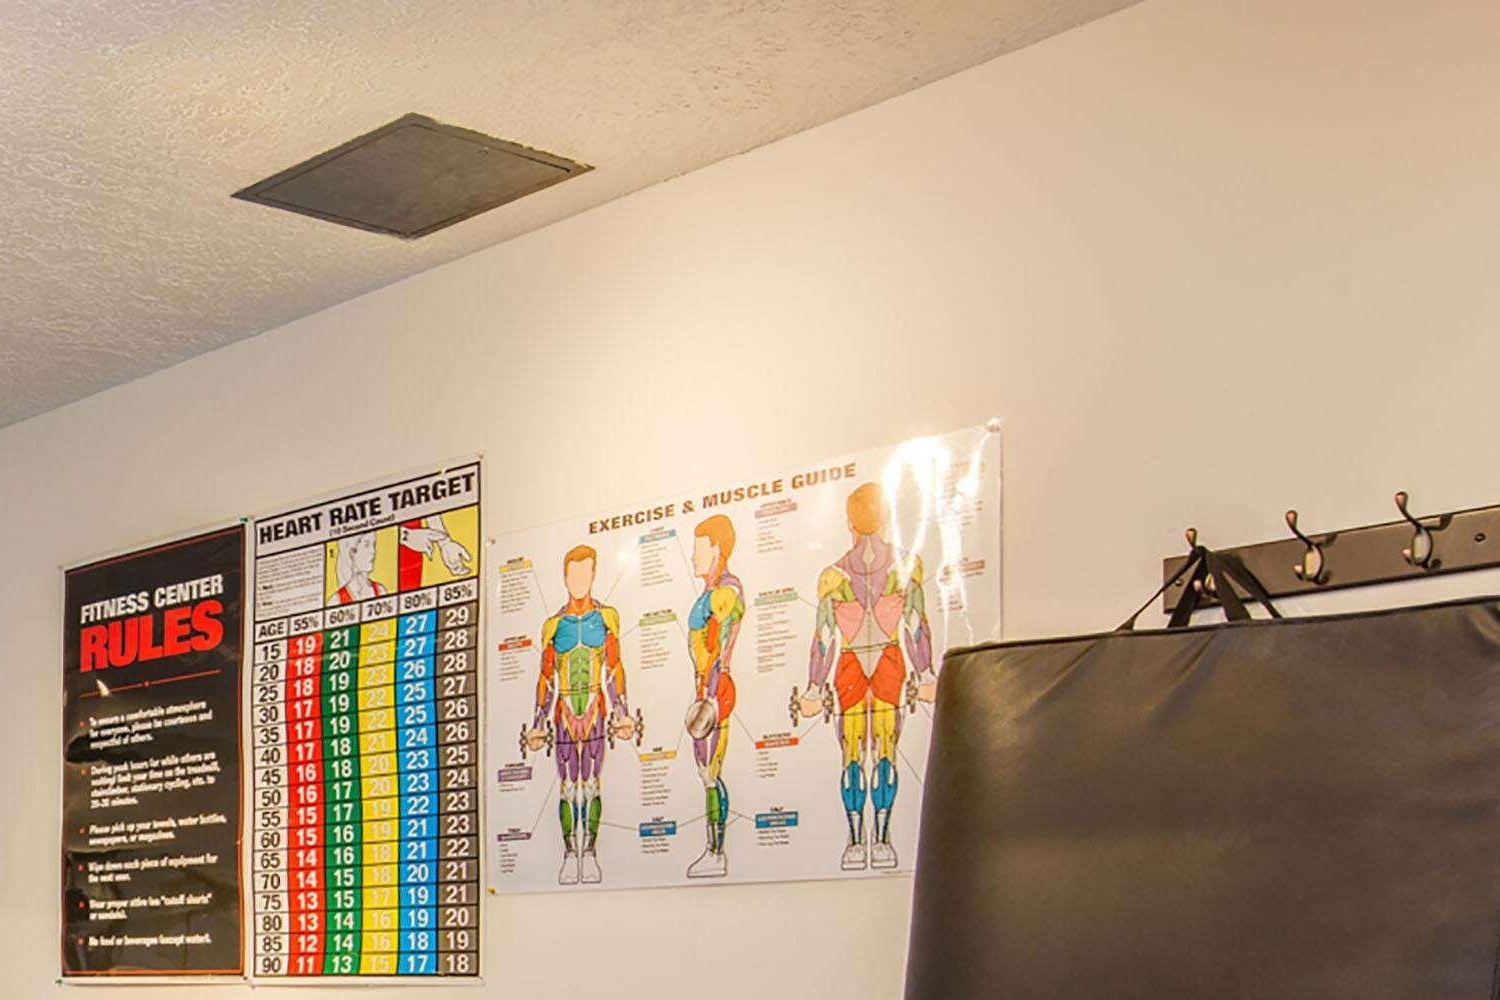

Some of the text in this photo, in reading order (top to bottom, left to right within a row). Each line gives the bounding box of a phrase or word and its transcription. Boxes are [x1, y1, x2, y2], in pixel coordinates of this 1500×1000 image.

[259, 472, 475, 545] HEART RATE TARGET
[589, 462, 857, 535] EXERCISE & MUSCLE GUIDE
[81, 591, 149, 625] FITNESS
[154, 574, 223, 609] CENTER
[259, 585, 472, 638] AGE 55% 60% 70% 80% 85%
[80, 600, 225, 673] RULES
[263, 643, 280, 660] 15
[297, 635, 316, 655] 19
[330, 629, 349, 648] 21
[406, 614, 428, 634] 27
[445, 608, 469, 627] 29
[260, 664, 279, 682] 20
[295, 657, 315, 676] 18
[329, 651, 351, 670] 20
[404, 637, 426, 657] 27
[444, 629, 468, 649] 28
[259, 685, 278, 702] 25
[294, 678, 313, 697] 18
[330, 672, 349, 691] 19
[404, 659, 426, 679] 26
[443, 653, 467, 673] 28
[259, 705, 279, 724] 30
[294, 699, 313, 718] 17
[329, 694, 349, 713] 19
[404, 682, 426, 702] 25
[444, 675, 467, 695] 27
[260, 726, 279, 744] 35
[295, 721, 313, 739] 17
[330, 715, 350, 735] 19
[405, 704, 427, 724] 25
[445, 698, 468, 718] 26
[261, 747, 281, 764] 40
[296, 742, 314, 760] 17
[331, 737, 351, 756] 18
[406, 728, 428, 747] 24
[445, 722, 469, 742] 26
[261, 768, 281, 785] 45
[297, 763, 316, 782] 16
[332, 759, 352, 778] 18
[406, 750, 429, 769] 23
[446, 745, 469, 764] 25
[262, 789, 281, 807] 50
[297, 785, 317, 803] 16
[333, 781, 352, 800] 17
[407, 773, 429, 792] 23
[447, 768, 469, 788] 24
[262, 810, 281, 828] 55
[298, 806, 317, 824] 15
[333, 803, 353, 821] 17
[407, 795, 429, 815] 22
[447, 792, 469, 811] 23
[261, 831, 280, 849] 60
[297, 828, 317, 846] 15
[334, 825, 354, 843] 16
[407, 818, 427, 837] 21
[447, 815, 469, 834] 23
[261, 852, 280, 869] 65
[297, 849, 317, 867] 14
[334, 846, 354, 865] 16
[407, 841, 426, 860] 21
[446, 838, 469, 857] 22
[261, 873, 281, 890] 70
[297, 871, 317, 888] 14
[334, 868, 354, 887] 15
[407, 863, 429, 882] 20
[446, 861, 466, 880] 21
[262, 894, 281, 910] 75
[298, 892, 318, 910] 13
[334, 890, 354, 908] 15
[408, 886, 429, 905] 19
[446, 885, 466, 903] 21
[262, 915, 282, 932] 80
[298, 913, 318, 931] 13
[334, 912, 354, 930] 14
[409, 909, 429, 928] 19
[446, 907, 469, 926] 20
[263, 936, 282, 953] 85
[298, 935, 318, 952] 12
[334, 933, 353, 951] 14
[408, 932, 428, 950] 18
[447, 931, 469, 950] 19
[262, 956, 281, 975] 90
[298, 956, 314, 973] 11
[332, 955, 352, 974] 13
[408, 954, 428, 973] 17
[446, 954, 469, 973] 18
